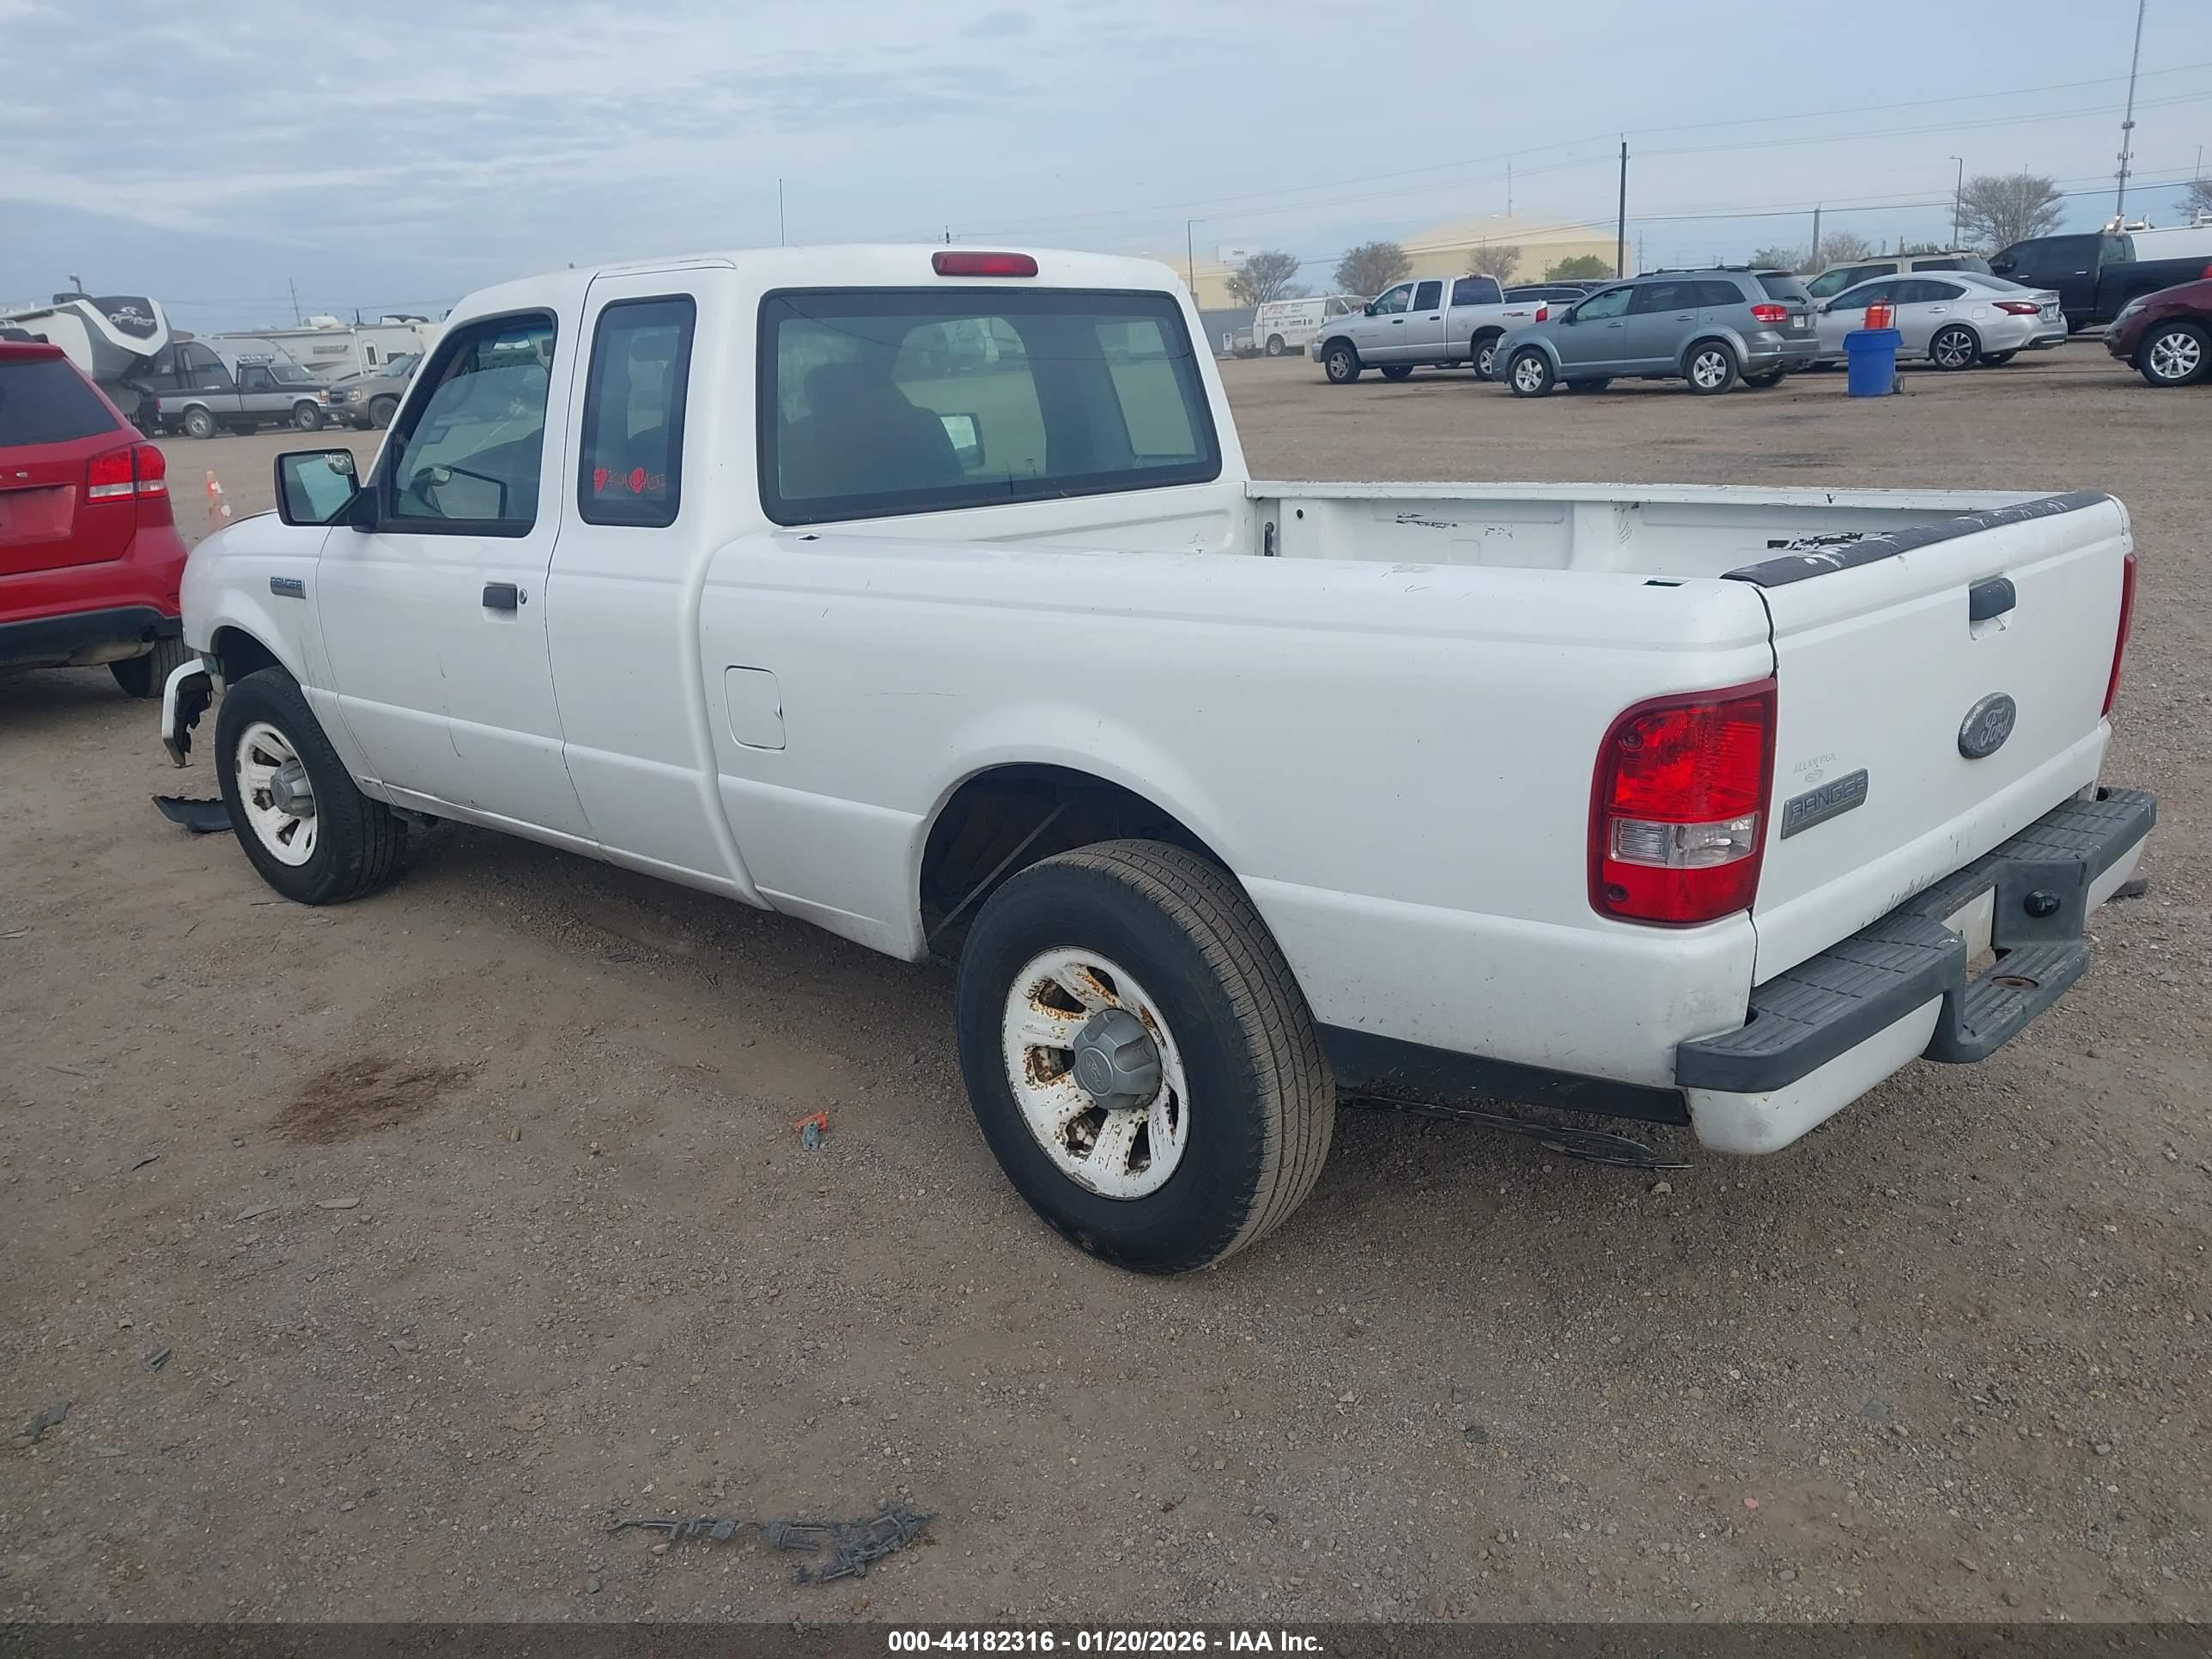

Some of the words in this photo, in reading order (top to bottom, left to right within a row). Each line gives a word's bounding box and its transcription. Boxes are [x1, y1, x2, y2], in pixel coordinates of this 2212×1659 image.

[270, 576, 303, 592] RANGER
[1980, 708, 2010, 747] Ford
[1789, 776, 1868, 826] RANGER
